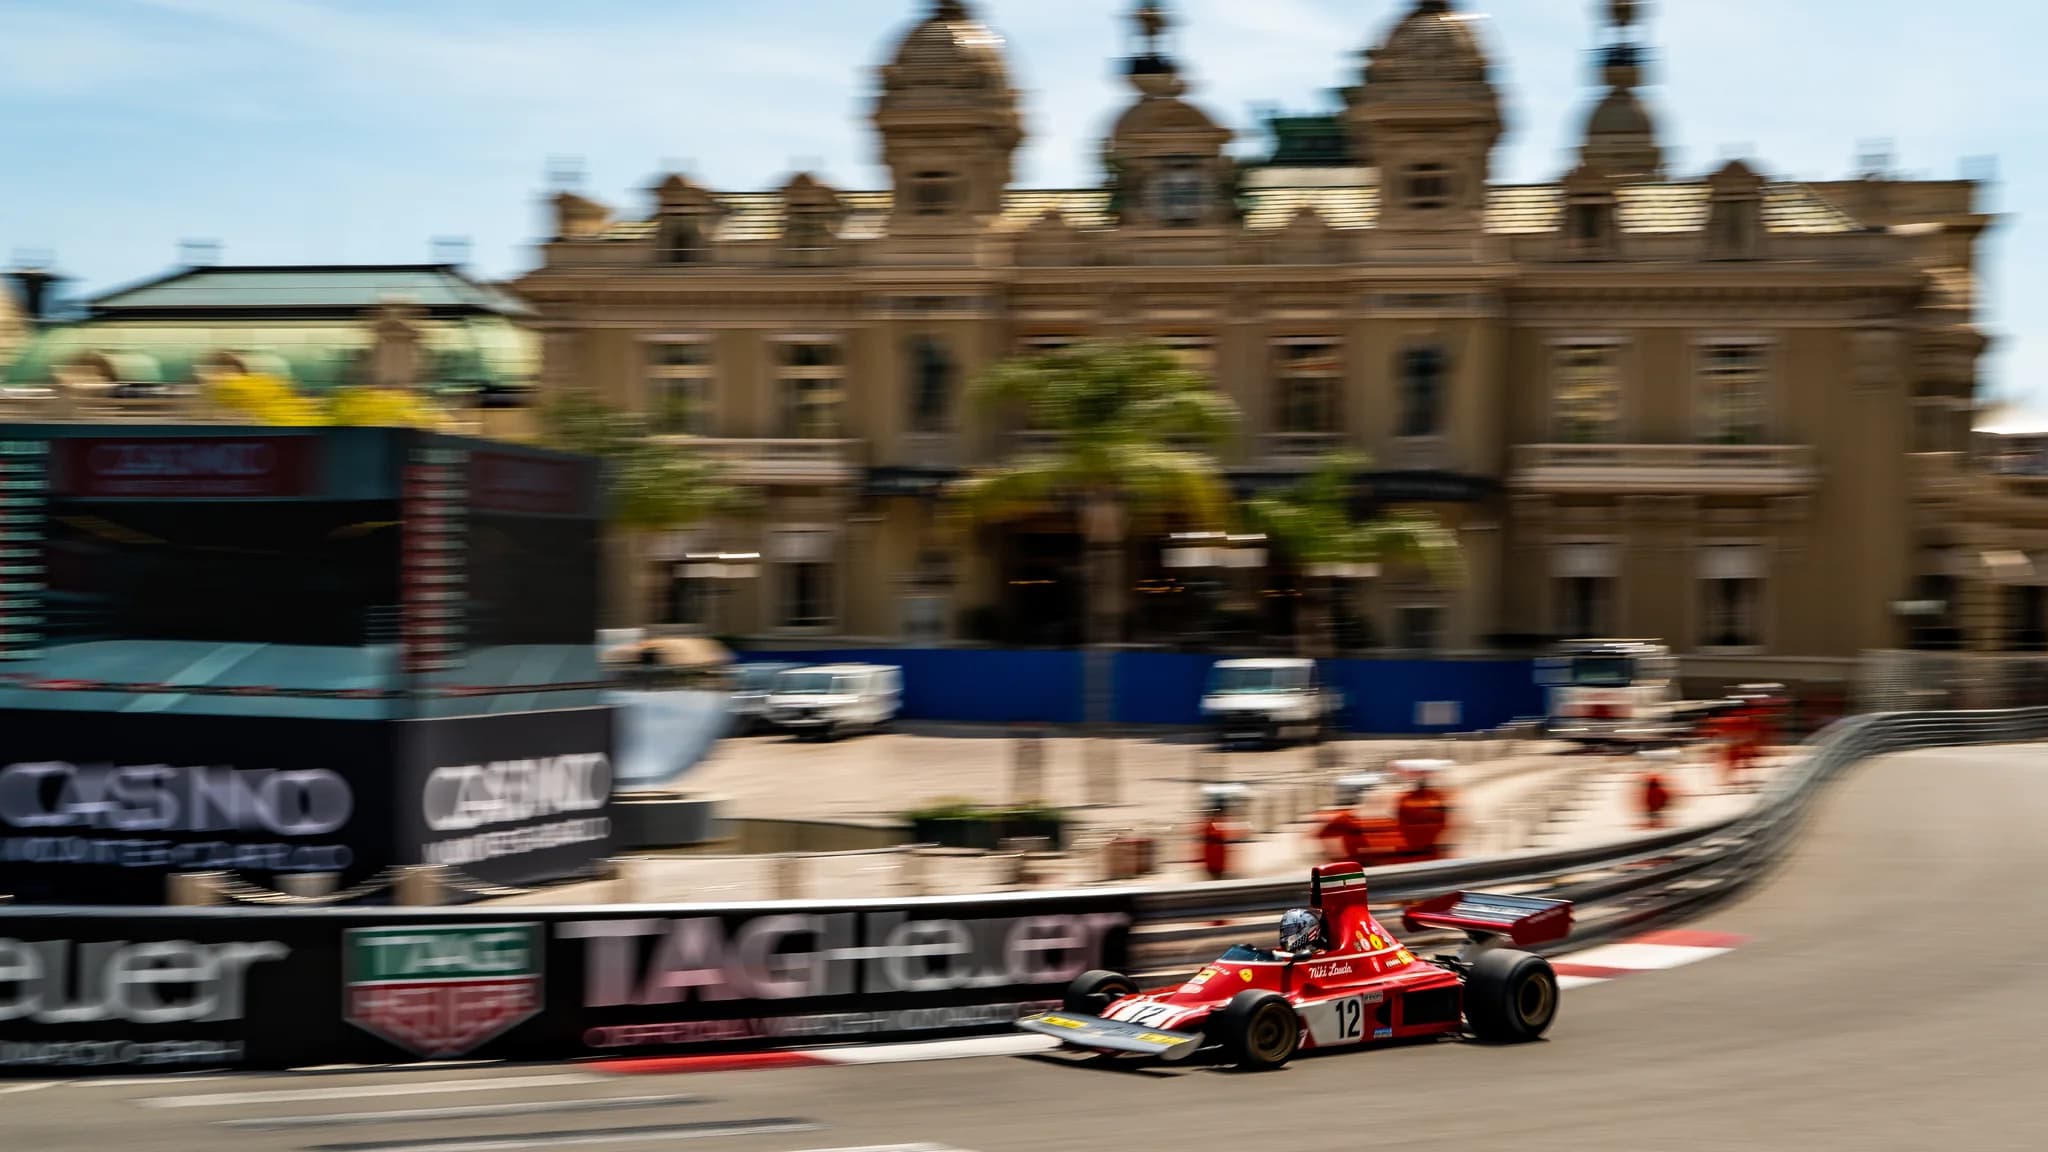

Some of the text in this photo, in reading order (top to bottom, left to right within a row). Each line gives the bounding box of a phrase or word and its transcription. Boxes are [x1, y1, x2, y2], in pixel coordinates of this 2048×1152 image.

[556, 913, 825, 1007] TAG
[1309, 962, 1353, 979] Niki Lauda
[1127, 1005, 1167, 1025] 12
[1335, 999, 1361, 1039] 12
